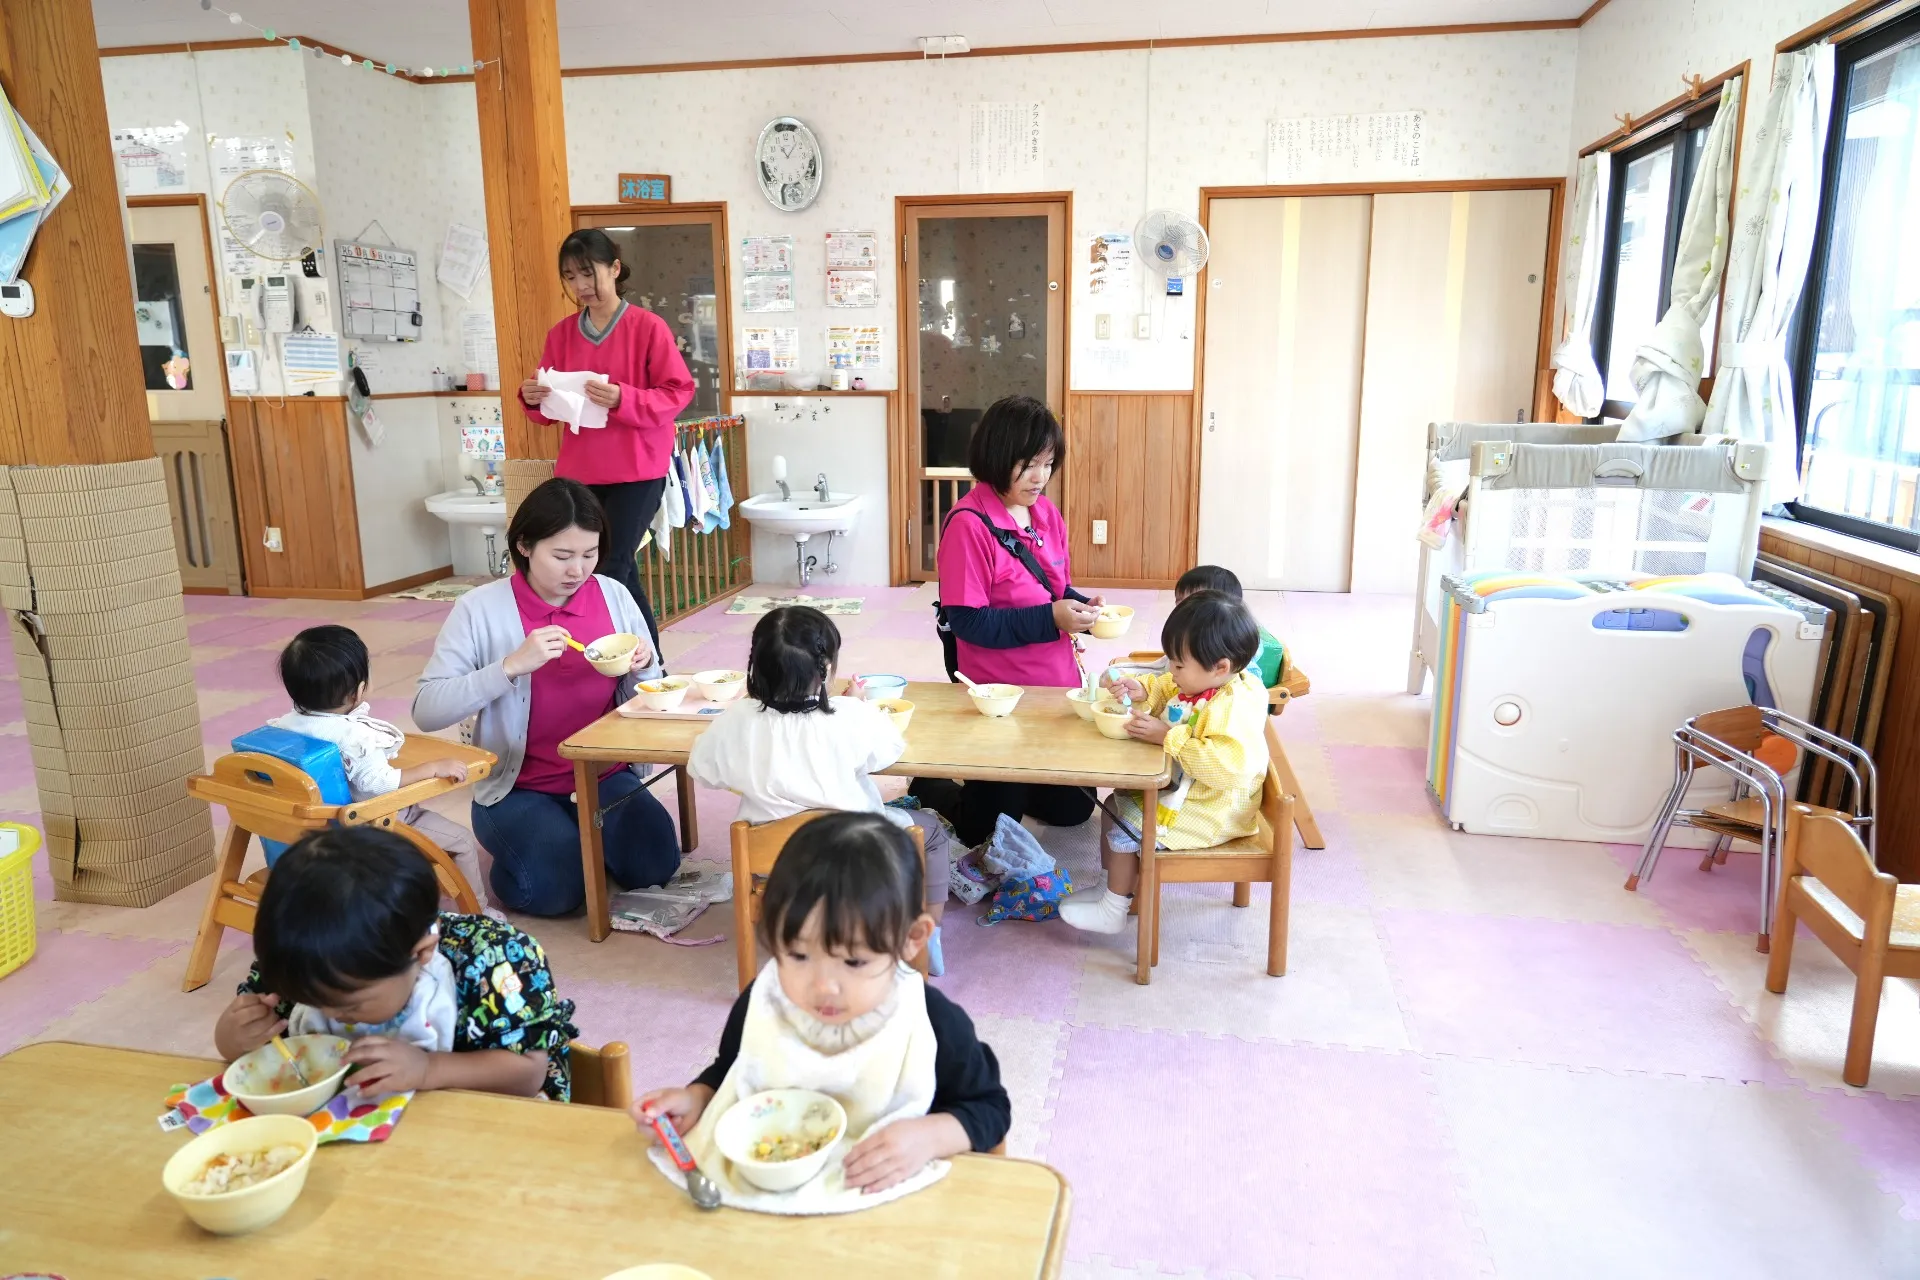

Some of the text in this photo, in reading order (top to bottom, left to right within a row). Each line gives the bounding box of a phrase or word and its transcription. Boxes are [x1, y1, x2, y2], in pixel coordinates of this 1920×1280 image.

[1411, 114, 1421, 167] あさのことば
[622, 178, 665, 200] 沐浴室
